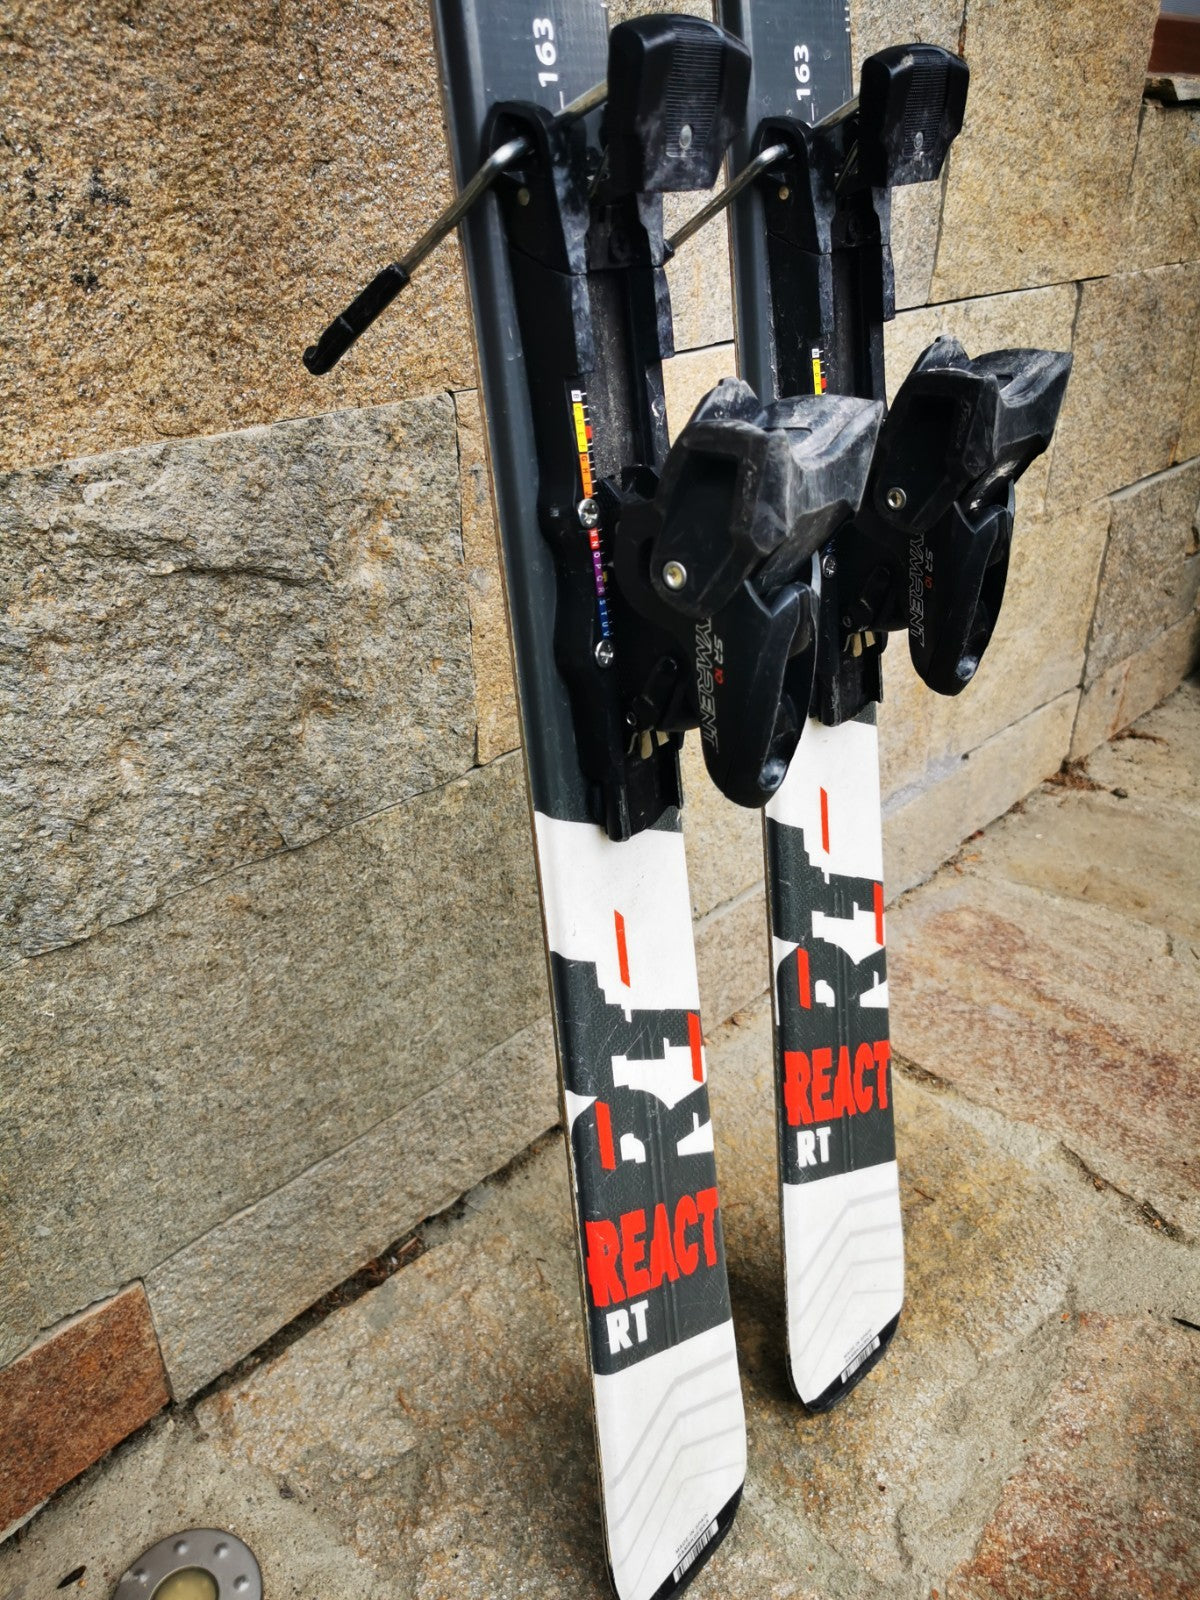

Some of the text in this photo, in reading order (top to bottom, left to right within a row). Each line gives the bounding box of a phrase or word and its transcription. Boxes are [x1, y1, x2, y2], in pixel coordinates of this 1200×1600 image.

[533, 18, 558, 87] 163
[794, 45, 811, 100] 163
[909, 528, 925, 648] YMRENT
[713, 634, 724, 665] SR
[696, 617, 720, 754] YMRENT
[784, 1040, 891, 1126] REACT
[797, 1127, 831, 1168] RT
[586, 1187, 718, 1307] REACT
[606, 1300, 649, 1355] RT
